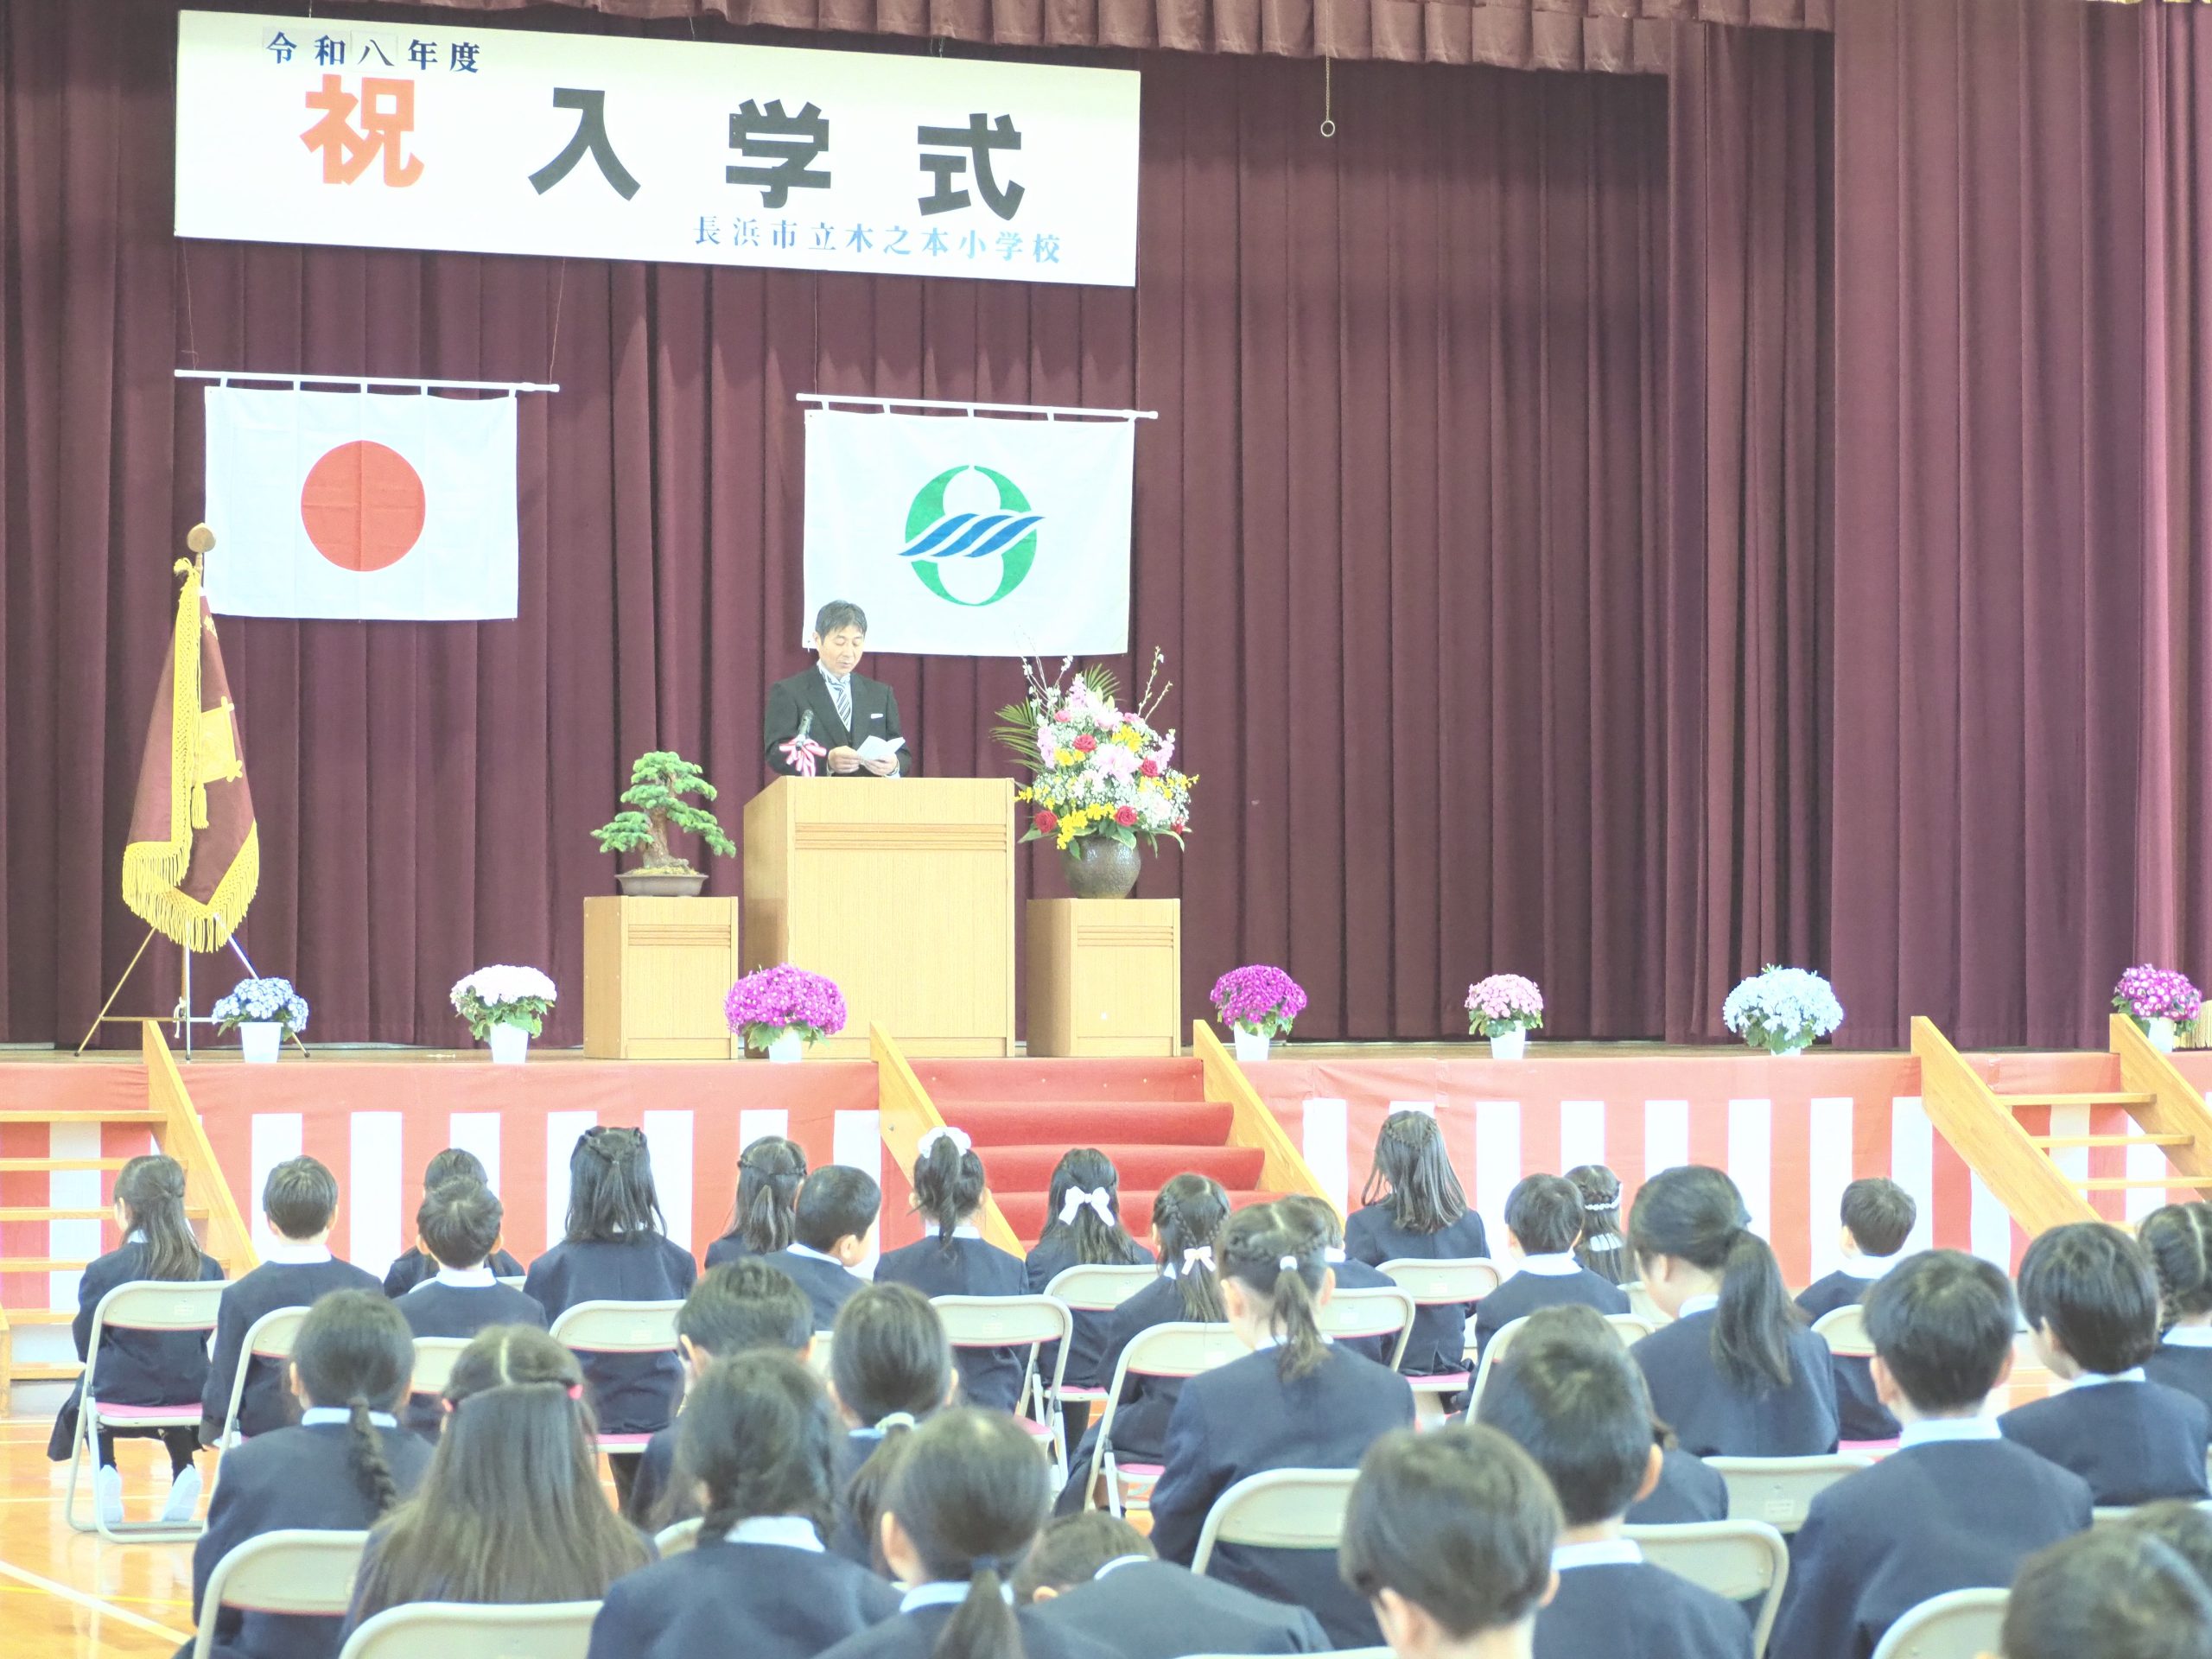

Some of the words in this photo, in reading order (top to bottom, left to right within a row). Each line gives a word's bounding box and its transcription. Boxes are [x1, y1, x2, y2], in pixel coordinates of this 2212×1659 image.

[266, 31, 480, 74] 令和八年度
[299, 73, 425, 188] 祝
[528, 86, 1027, 221] 入学式
[692, 215, 1061, 264] 長浜市立木之本小学校
